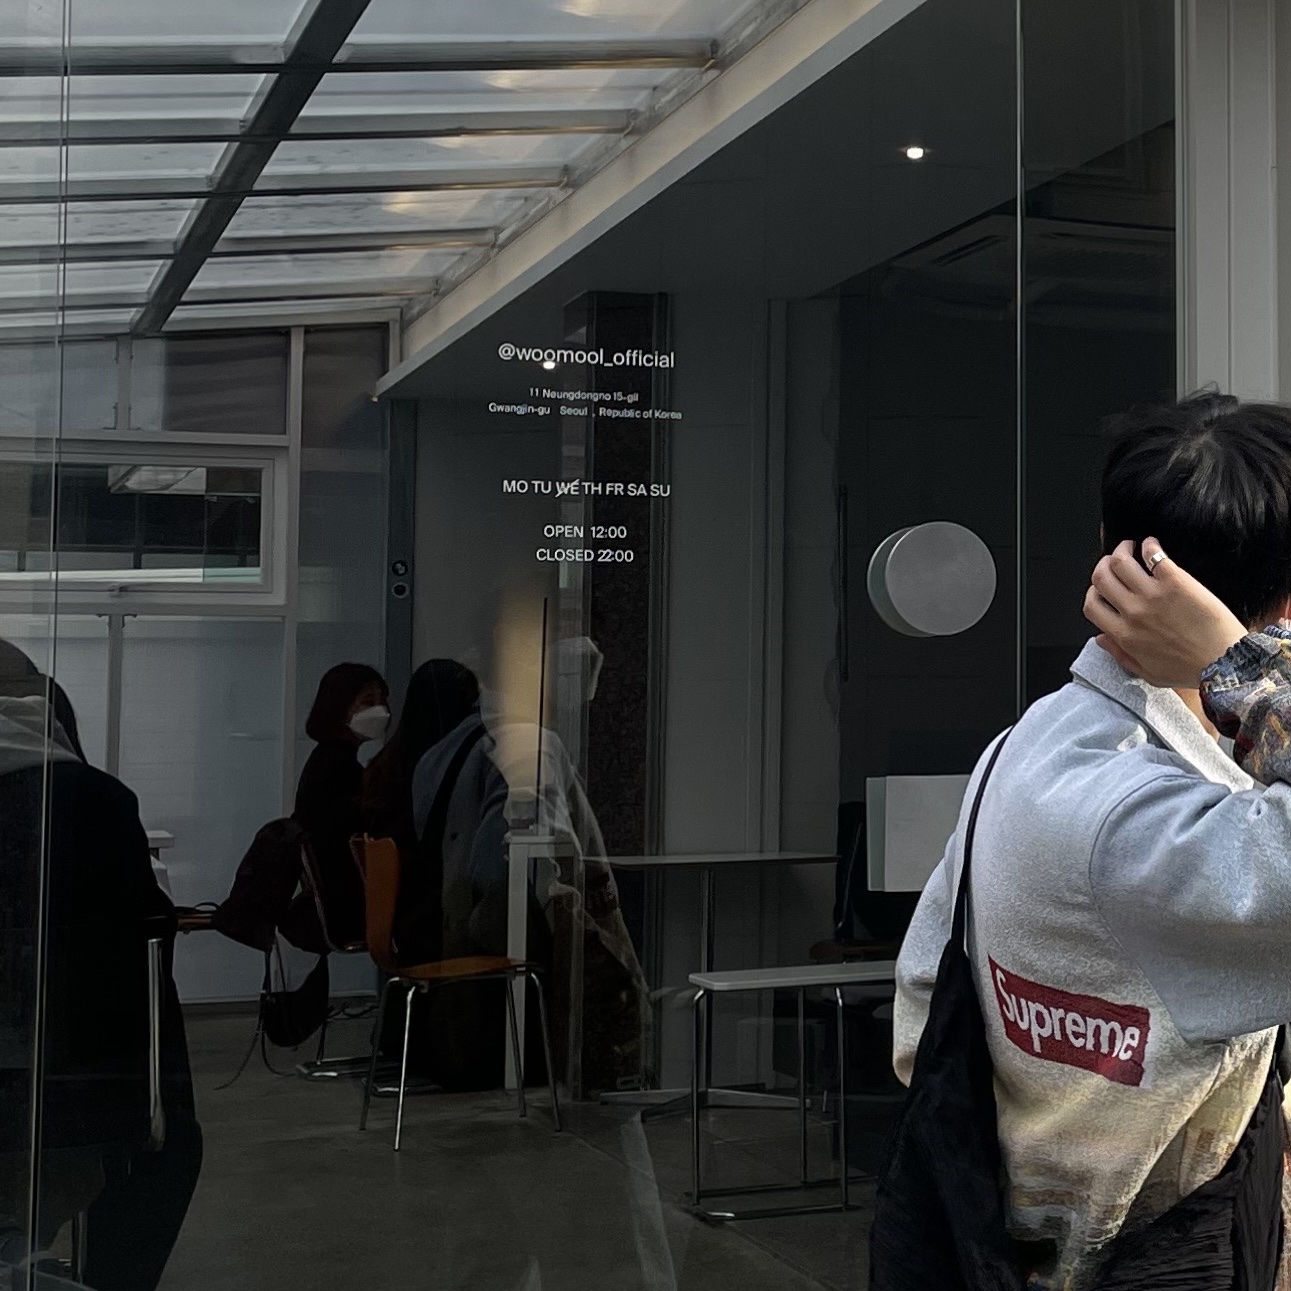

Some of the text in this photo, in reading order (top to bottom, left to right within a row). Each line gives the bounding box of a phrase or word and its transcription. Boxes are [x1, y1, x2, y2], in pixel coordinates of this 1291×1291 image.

[498, 343, 675, 368] @woomool_official
[488, 402, 551, 415] Gwangjin-gu
[559, 405, 588, 416] Seoul
[599, 407, 641, 418] Republic
[642, 409, 652, 418] of
[654, 409, 682, 419] Korea
[503, 479, 529, 493] MO
[531, 480, 552, 494] TU
[581, 481, 602, 495] TH
[605, 482, 625, 496] FR
[626, 483, 648, 496] SA
[649, 484, 671, 497] SU
[543, 524, 627, 539] OPEN 12:00
[536, 548, 634, 563] CLOSED 22:00
[996, 968, 1140, 1061] Supreme
